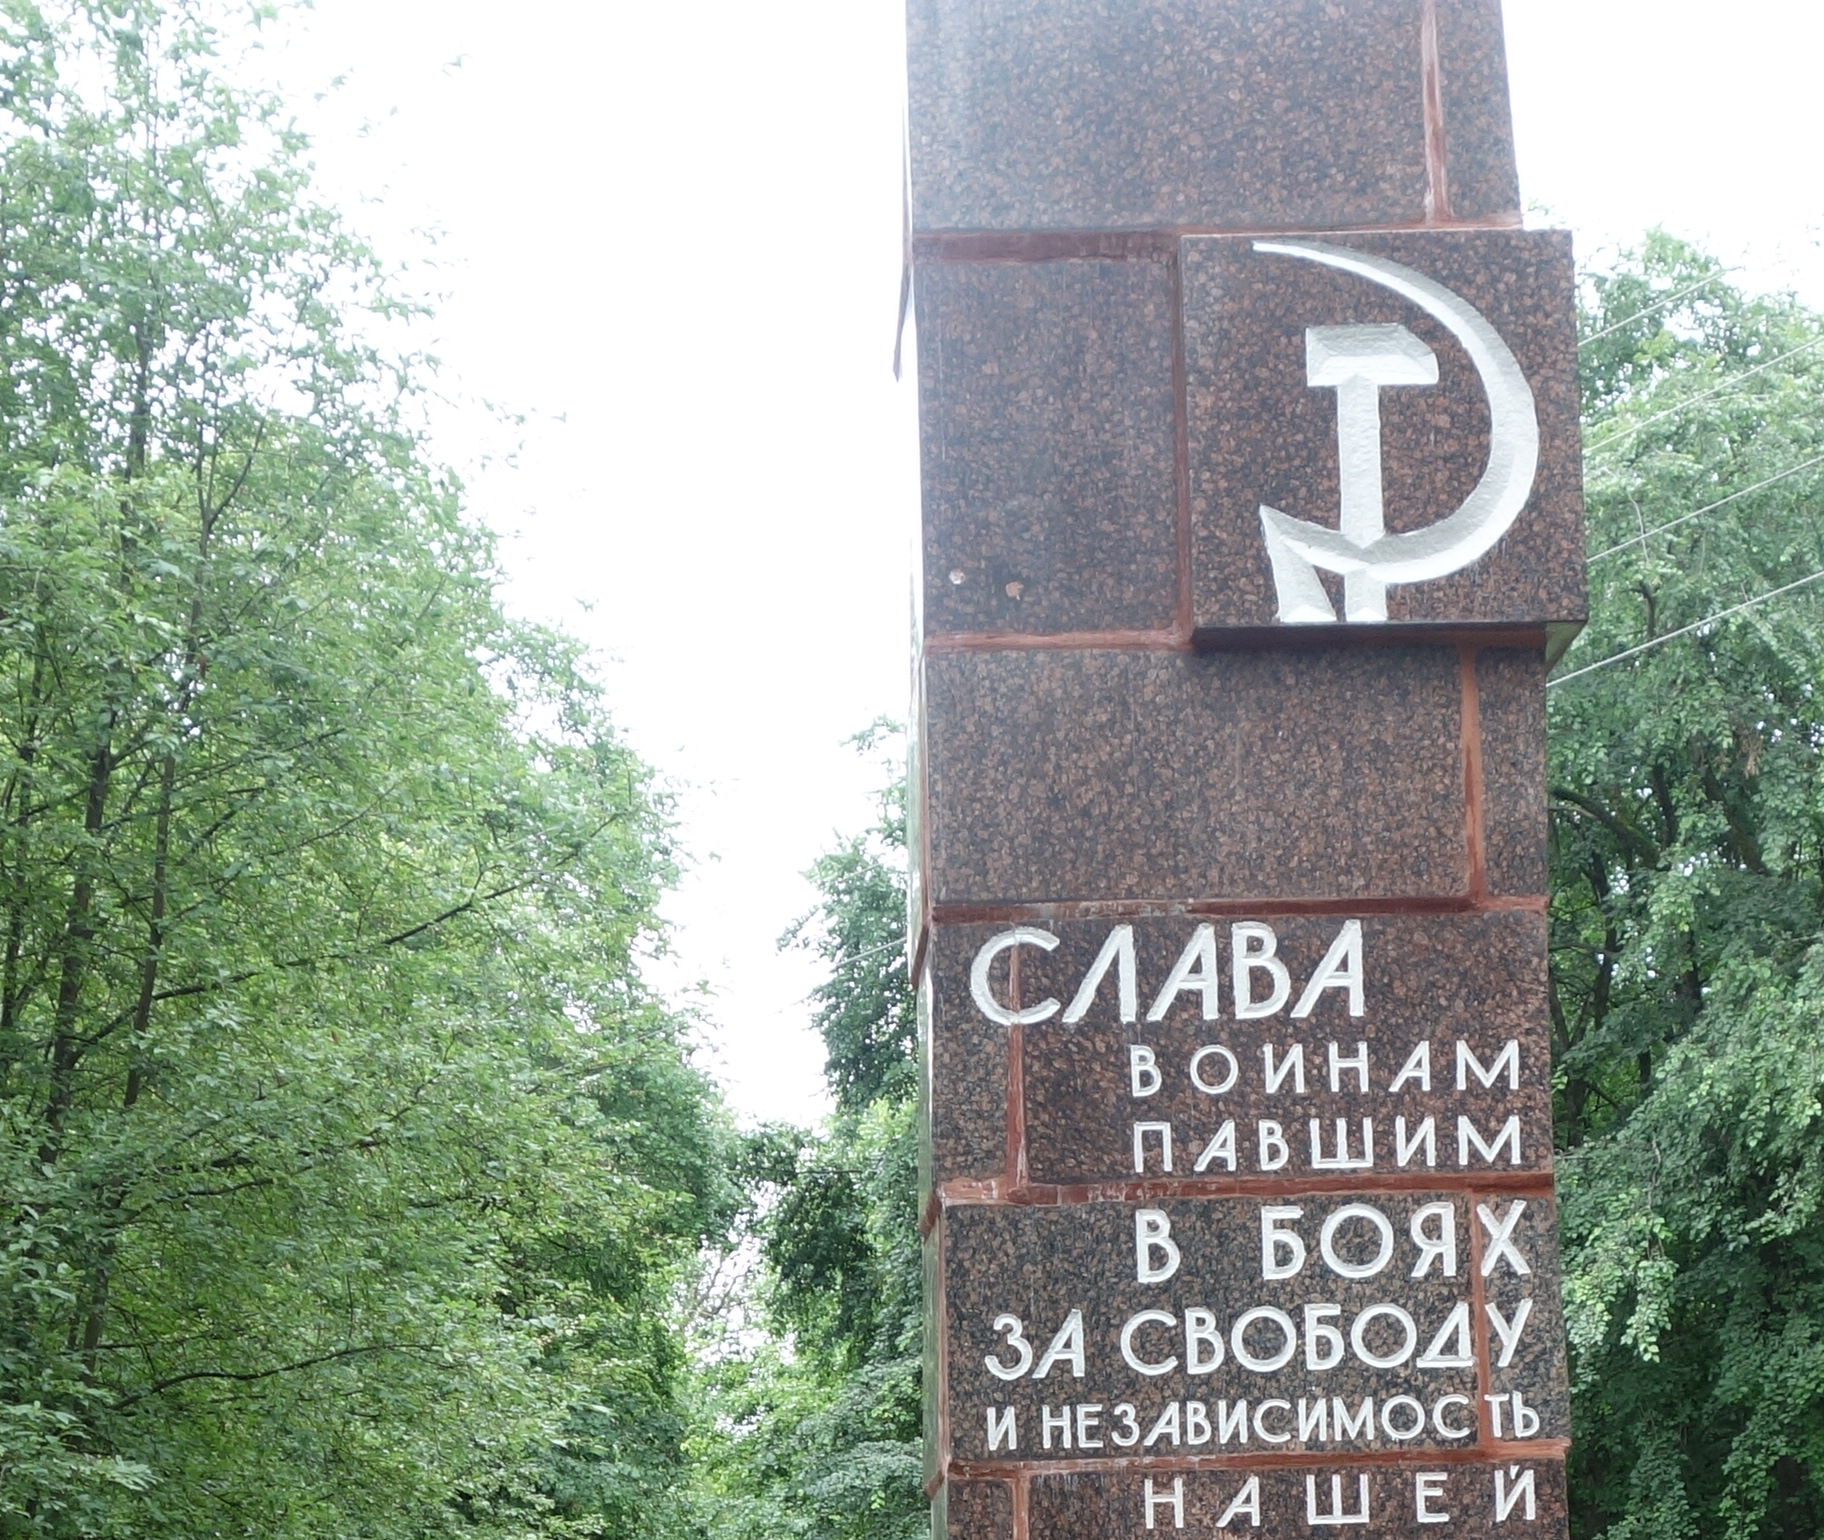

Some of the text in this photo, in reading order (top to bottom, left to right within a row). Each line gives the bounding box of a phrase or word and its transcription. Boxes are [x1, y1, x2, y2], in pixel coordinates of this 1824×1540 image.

[970, 919, 1365, 1025] СЛАВА
[1130, 1040, 1521, 1098] ВОИНАМ
[1133, 1115, 1522, 1173] ПАВШИМ
[1136, 1199, 1530, 1284] В БОЯХ
[984, 1297, 1534, 1380] ЗА СВОБОДУ
[986, 1392, 1541, 1451] И НЕЗАВИСИМОСТЬ
[1144, 1464, 1537, 1530] НАШЕЙ
